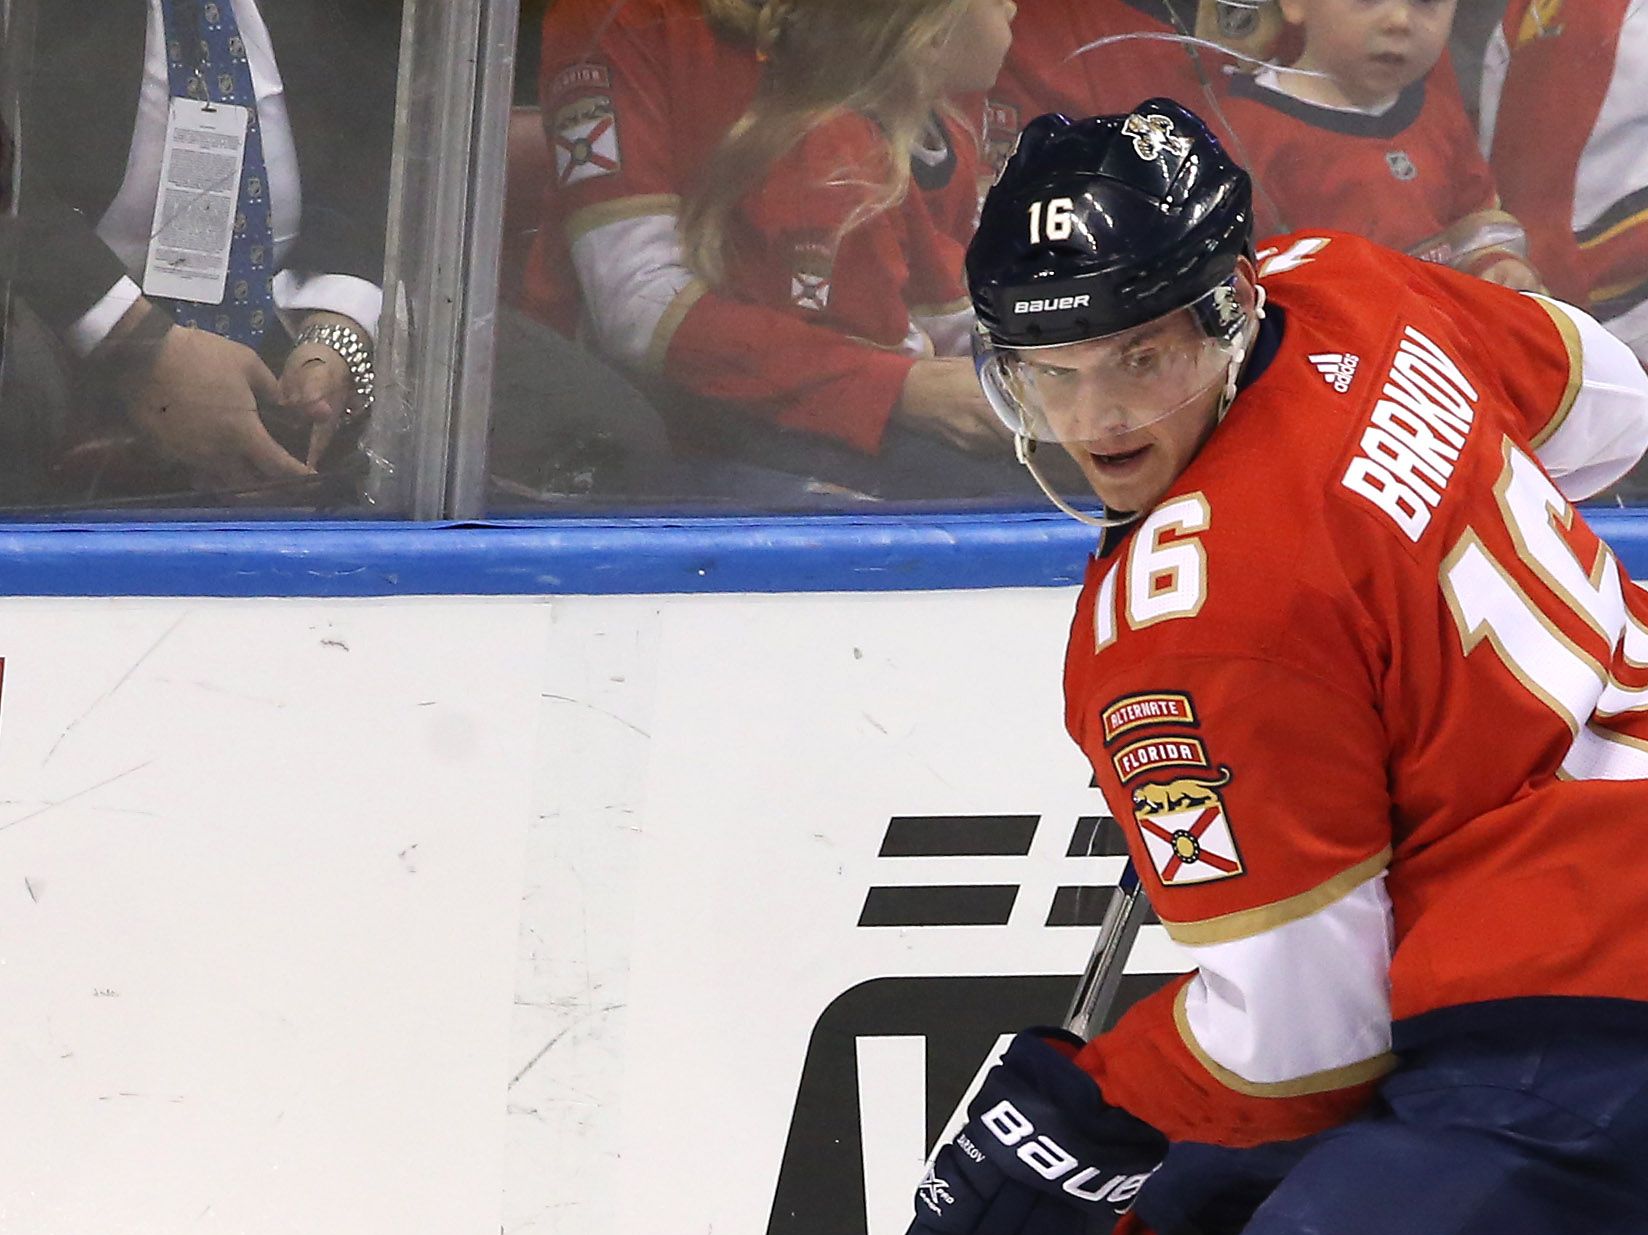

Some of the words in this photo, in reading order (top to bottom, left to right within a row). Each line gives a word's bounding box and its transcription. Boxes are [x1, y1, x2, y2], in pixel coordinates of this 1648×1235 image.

[1028, 197, 1074, 245] 16
[1014, 294, 1091, 314] BAUER
[1333, 353, 1360, 393] adidas
[1341, 325, 1479, 543] BARKOV
[1094, 490, 1211, 656] 16
[1111, 701, 1179, 729] ALTERNATE
[1123, 744, 1193, 772] FLORIDA
[980, 1099, 1155, 1214] BAUE
